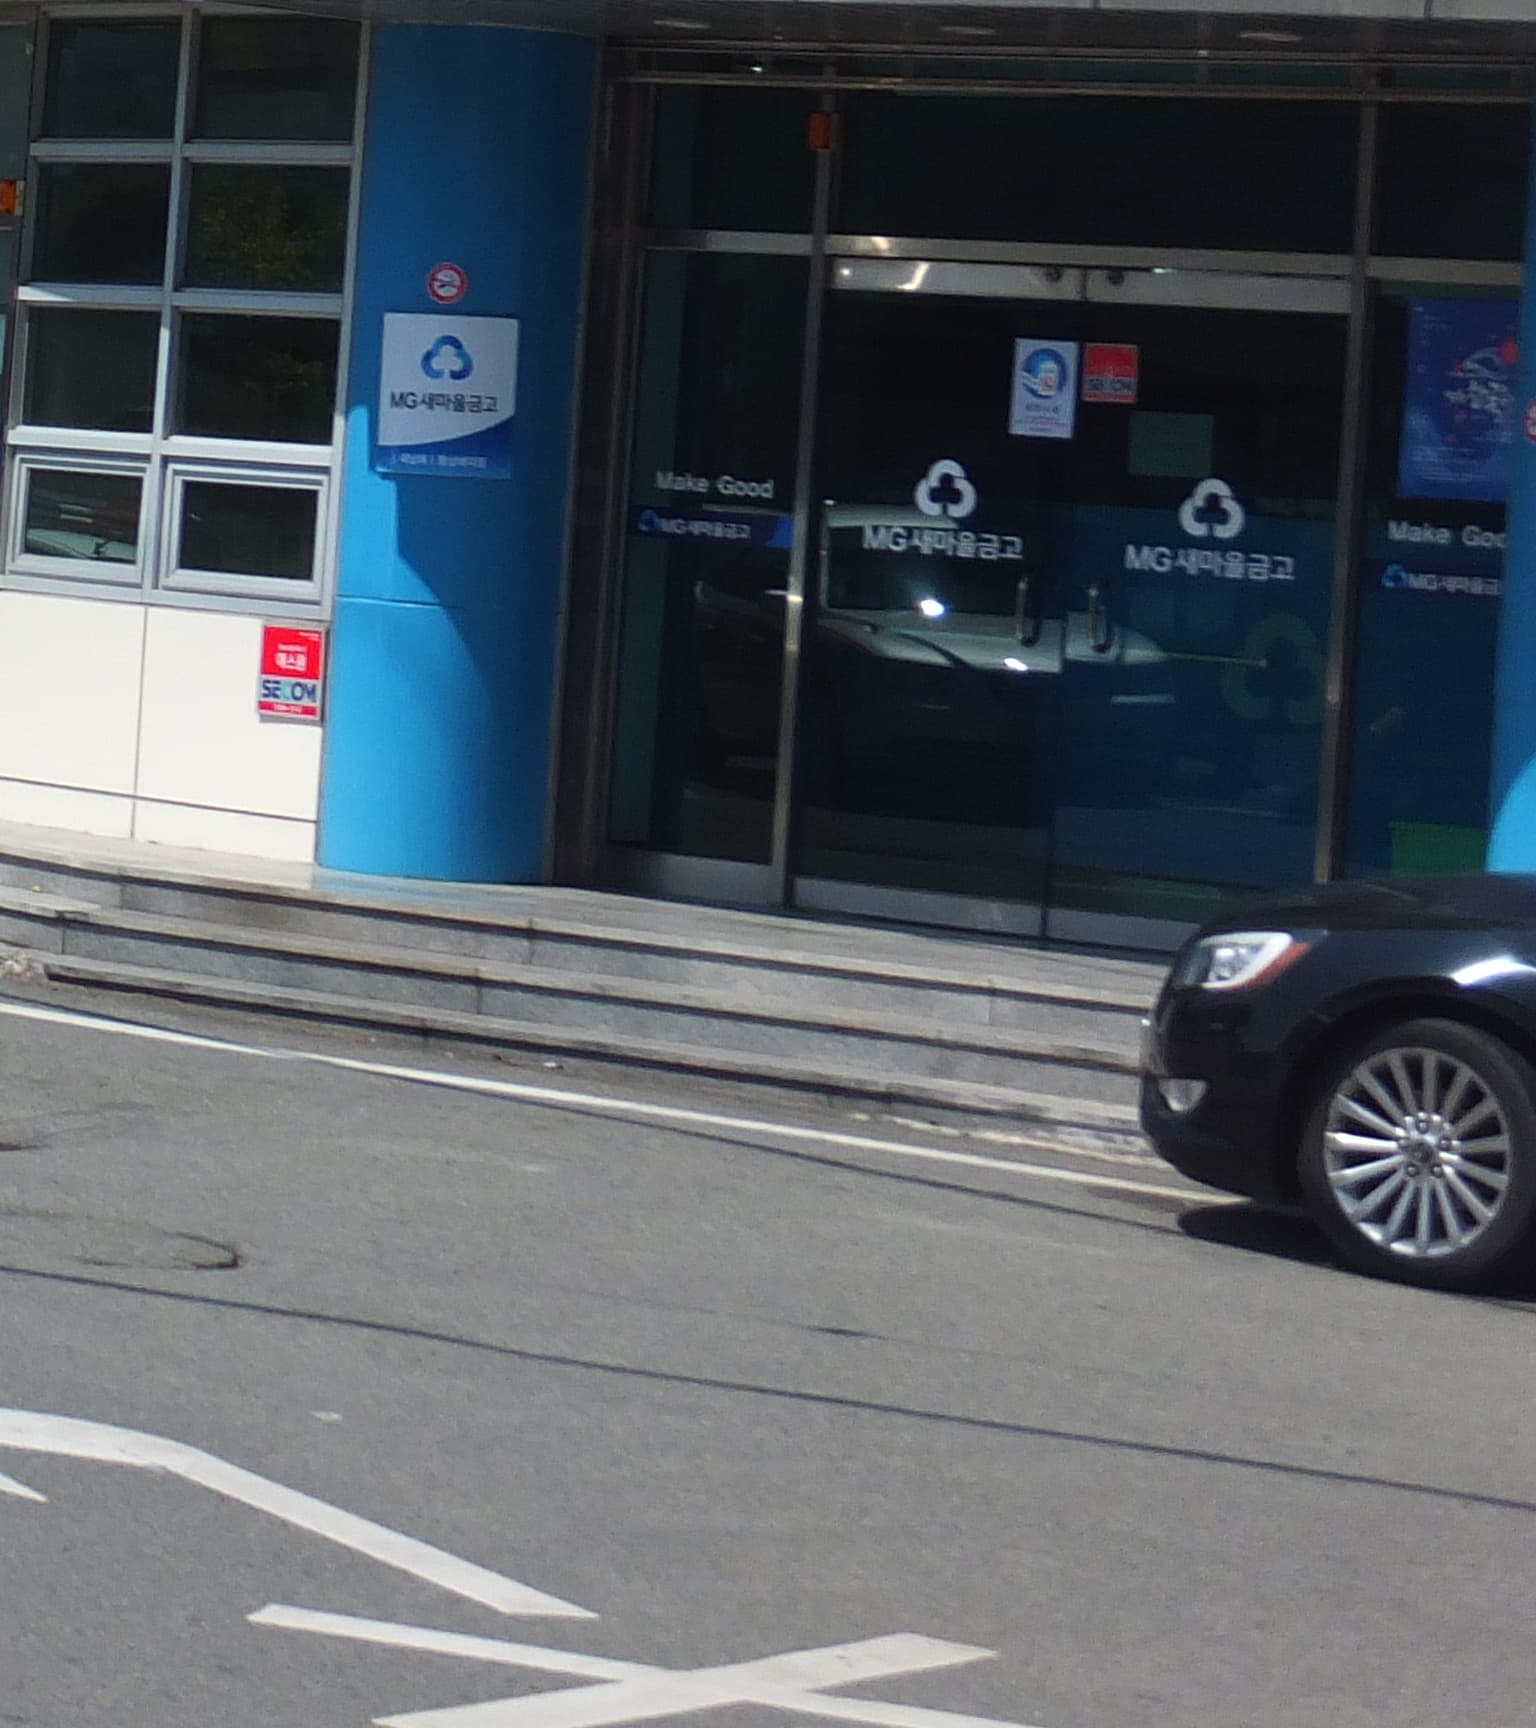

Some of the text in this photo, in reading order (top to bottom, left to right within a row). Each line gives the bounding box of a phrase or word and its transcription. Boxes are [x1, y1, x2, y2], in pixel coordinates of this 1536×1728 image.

[655, 470, 775, 499] Make Good
[1388, 520, 1451, 545] Make
[261, 678, 317, 703] SECOM
